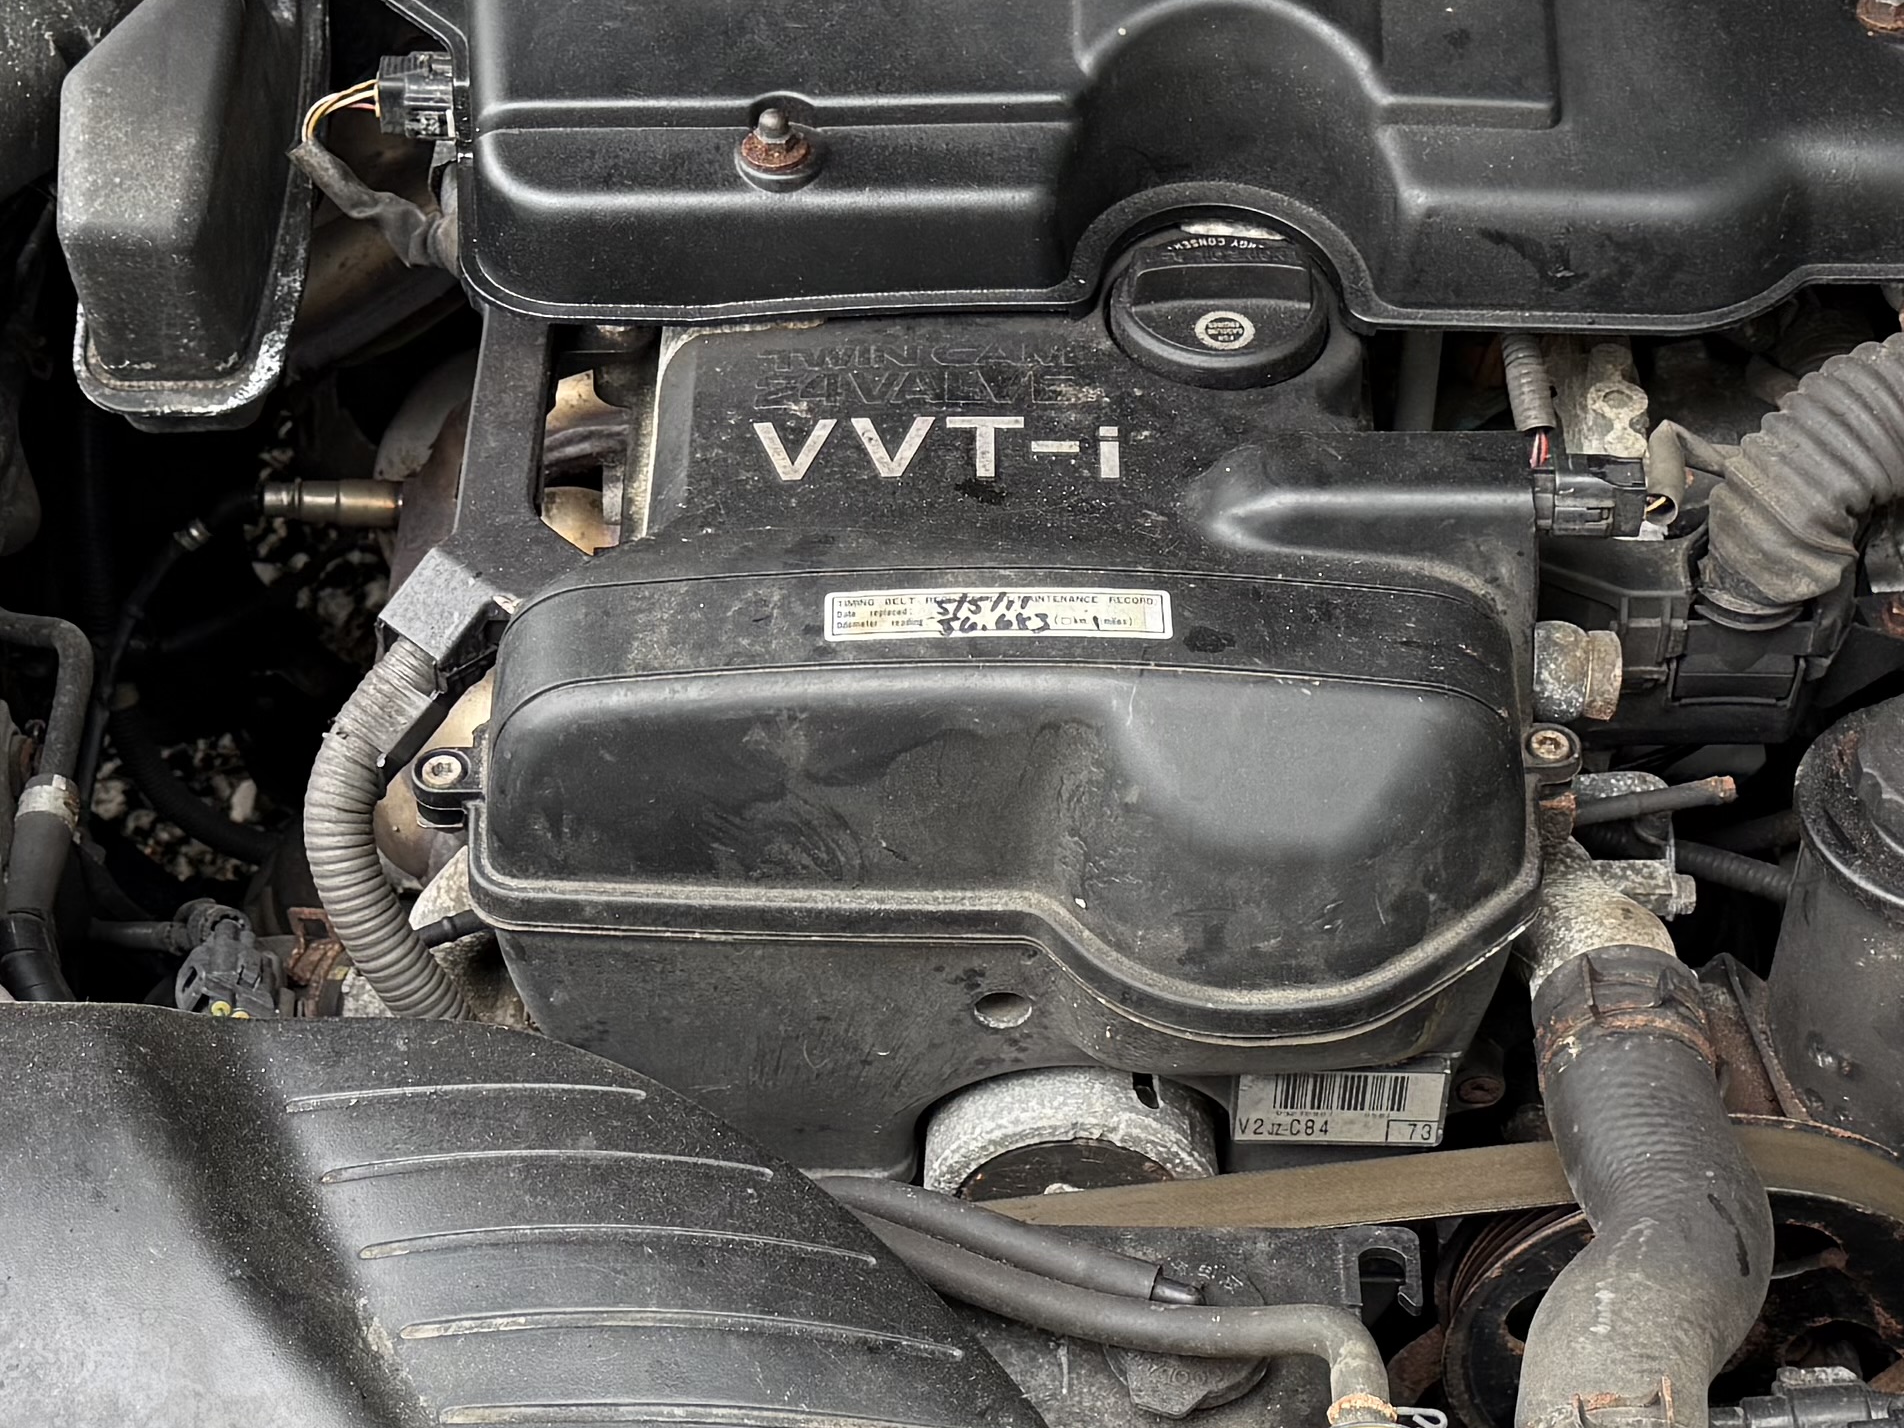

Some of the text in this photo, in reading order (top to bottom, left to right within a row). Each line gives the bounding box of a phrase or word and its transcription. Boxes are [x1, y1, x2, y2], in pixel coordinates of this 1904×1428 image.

[756, 342, 1077, 372] TWIN CAM
[753, 416, 1120, 481] VVT-i
[884, 597, 916, 606] BELT
[1108, 595, 1154, 606] RECORD
[1238, 1118, 1433, 1141] V2JZ-C84 73
